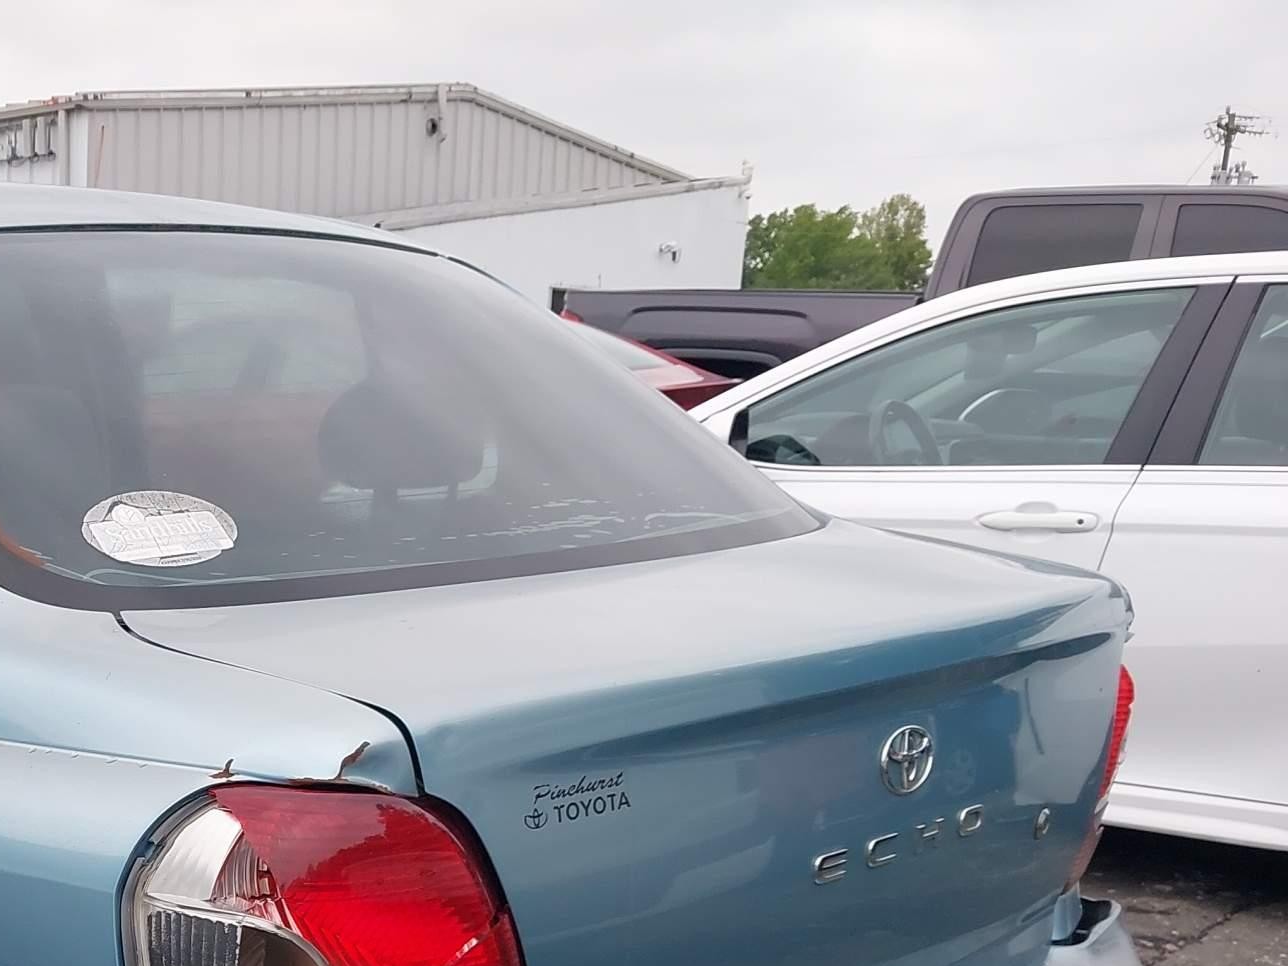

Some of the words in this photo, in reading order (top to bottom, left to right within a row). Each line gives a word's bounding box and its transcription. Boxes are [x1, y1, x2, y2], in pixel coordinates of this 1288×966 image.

[533, 772, 624, 804] Pinehurst
[553, 792, 631, 823] TOYOTA
[814, 804, 984, 885] ECHO
